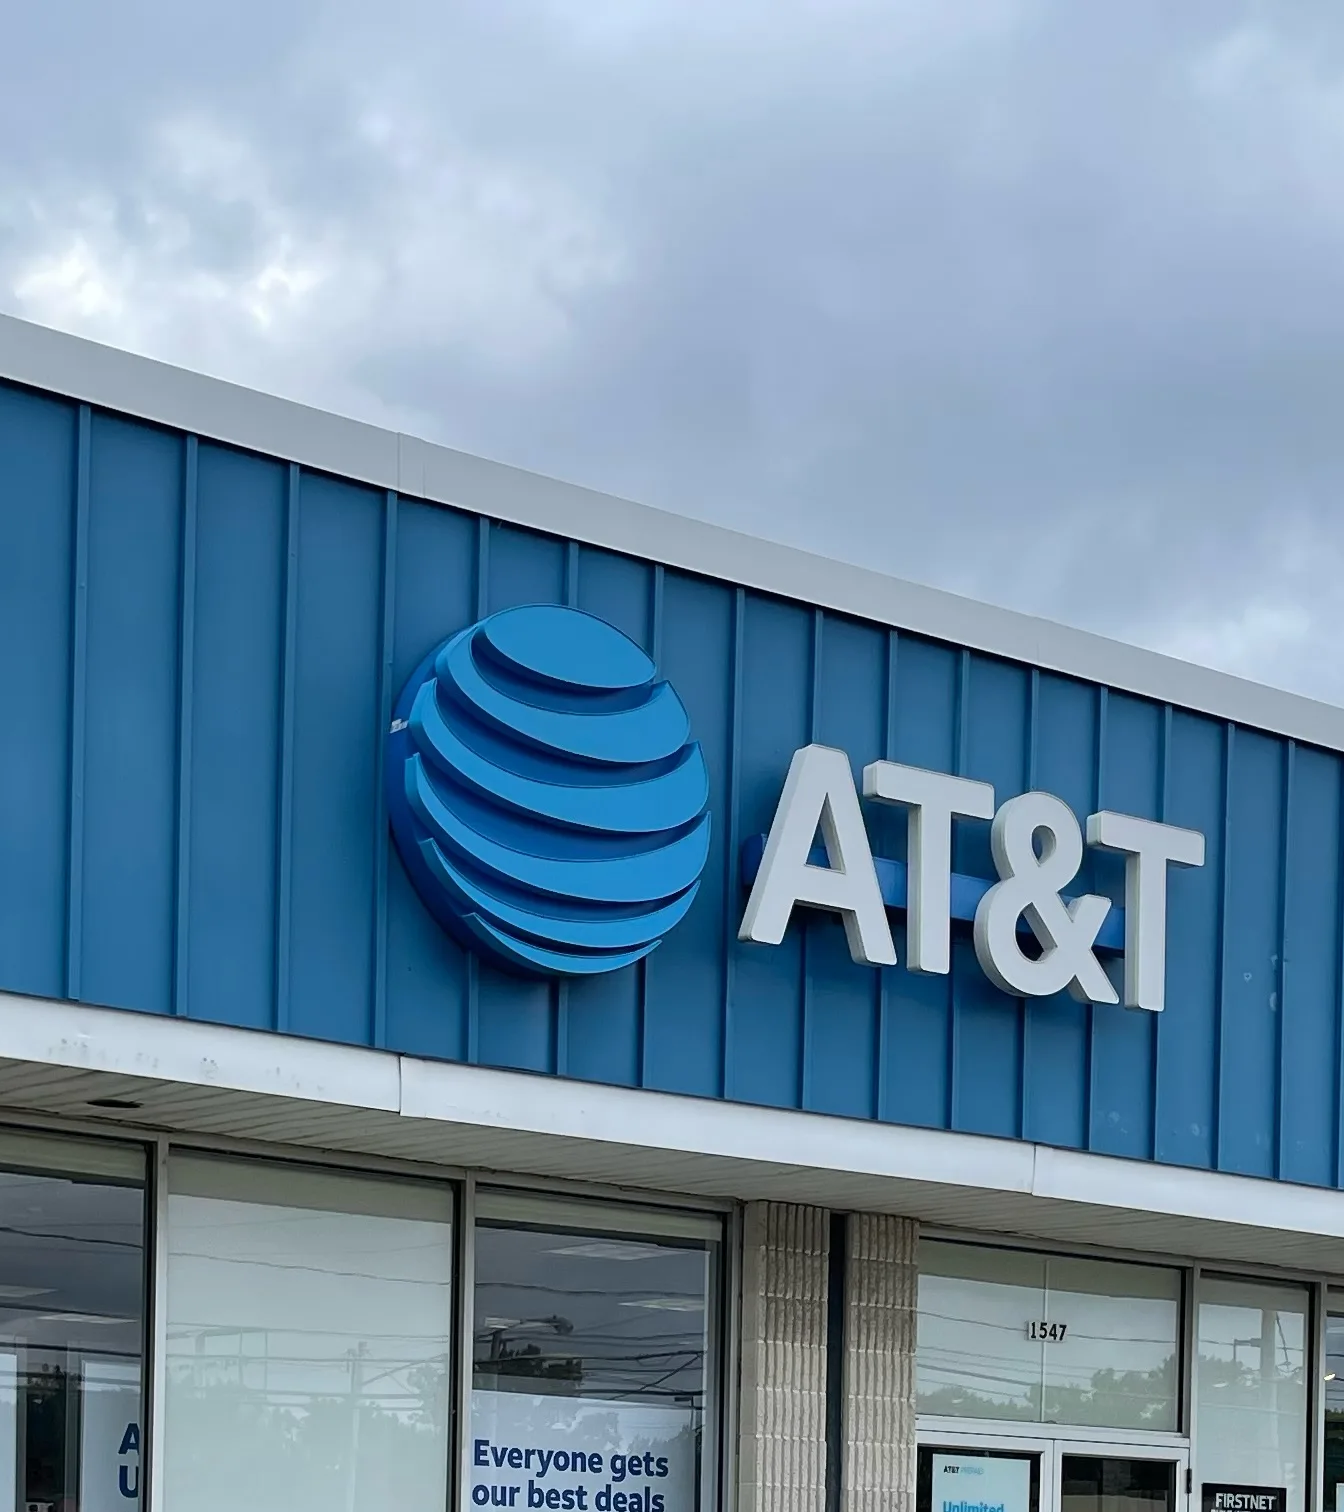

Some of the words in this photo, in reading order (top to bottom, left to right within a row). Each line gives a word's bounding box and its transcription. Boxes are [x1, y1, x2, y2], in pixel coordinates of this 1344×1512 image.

[737, 743, 1205, 1012] AT&T
[1031, 1322, 1067, 1341] 1547
[473, 1439, 603, 1478] Everyone
[610, 1452, 669, 1482] gets
[472, 1484, 520, 1507] our
[528, 1480, 588, 1511] best
